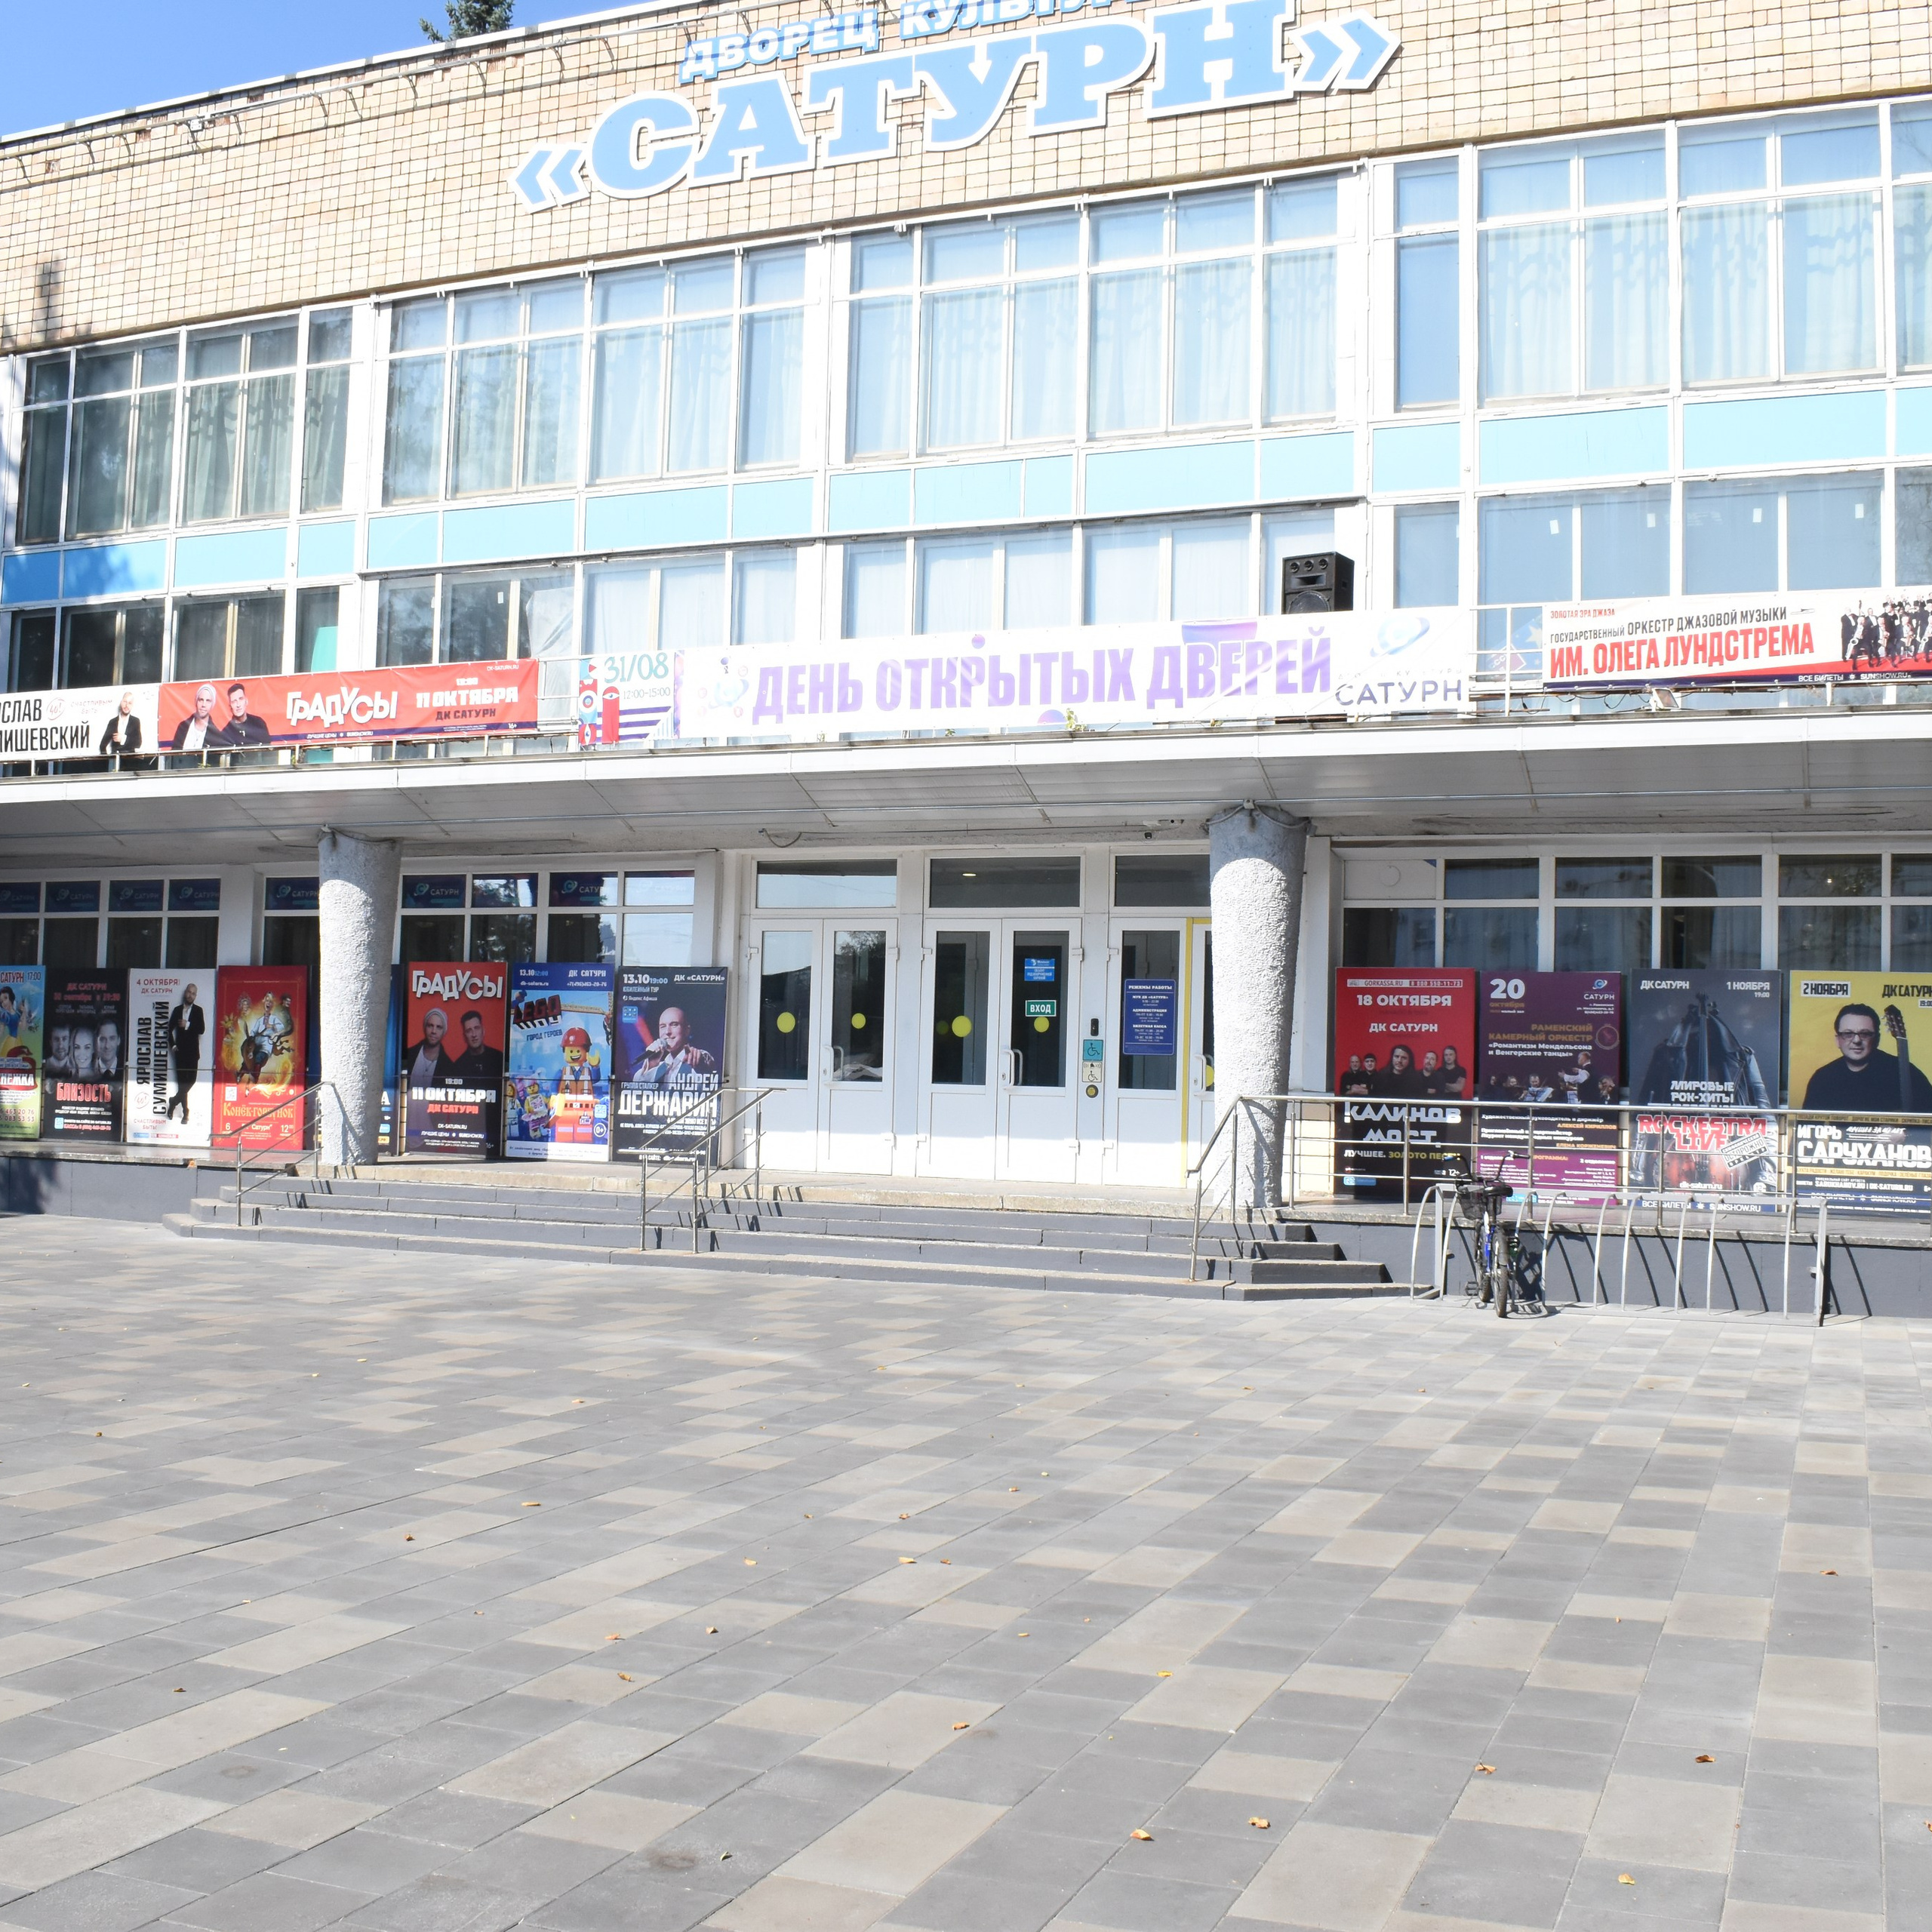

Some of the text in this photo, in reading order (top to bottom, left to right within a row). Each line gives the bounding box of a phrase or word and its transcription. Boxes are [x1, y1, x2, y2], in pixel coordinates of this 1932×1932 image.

[680, 0, 1151, 84] ДВОРЕЦ КУЛЬ
[506, 0, 1403, 214] «САТУРН»
[1550, 608, 1615, 619] ЗОЛОТАЯ ЭРА ДЖАЗА
[1550, 606, 1786, 644] ГОСУДАРСТВЕННЫЙ ОРКЕСТР ДЖАЗОВОЙ МУЗЫКИ
[1550, 623, 1814, 678] ИМ. ОЛЕГА ЛУНДСТРЕМА
[605, 652, 669, 684] 31/08
[752, 626, 1331, 725] ДЕНЬ ОТКРЫТЫХ ДВЕРЕЙ
[417, 687, 518, 708] 11 ОКТЯБРЯ
[623, 687, 671, 700] 12:00-15:00
[1335, 679, 1462, 706] САТУРН
[0, 699, 42, 724] СЛАВ
[435, 708, 496, 721] ДК САТУРН
[27, 971, 41, 980] 17:00
[623, 974, 650, 984] 13.10
[1490, 978, 1525, 999] 20
[1640, 980, 1770, 990] ДК САТУРН 1 НОЯБРЯ
[1803, 983, 1809, 994] 2
[1810, 983, 1848, 995] НОЯБРЯ
[1882, 984, 1898, 998] ДК
[1356, 995, 1452, 1006] 18 ОКТЯБРЯ
[513, 994, 561, 1024] LEGO
[1030, 1004, 1051, 1014] ВХОД
[515, 1015, 562, 1029] ШОУ
[1369, 1023, 1438, 1032] ДК САТУРН
[1531, 1023, 1593, 1032] РАМЕНСКИЙ
[526, 1029, 562, 1041] ГОРОД ГЕРОЕВ
[1488, 1032, 1545, 1041] КАМЕРНЫЙ
[137, 1017, 151, 1085] ЯРОСЛАВ
[152, 1001, 170, 1115] СУМИШЕВСКИЙ
[668, 1071, 718, 1091] АНДРЕЙ
[1670, 1080, 1734, 1091] МИРОВЫЕ
[56, 1082, 112, 1103] БЛИЗОСТЬ
[411, 1087, 497, 1103] 11 ОКТЯБРЯ
[1671, 1092, 1734, 1103] РОК-ХИТЫ
[427, 1103, 479, 1114] ДК САТУРН
[618, 1090, 718, 1118] ДЕРЖАВИН
[225, 1122, 231, 1131] 6
[1636, 1114, 1768, 1136] ROCKESTRA
[1797, 1124, 1842, 1140] ИГОРЬ
[1673, 1131, 1728, 1152] LIVE
[1344, 1149, 1386, 1158] ЛУЧШЕЕ.
[1724, 1139, 1764, 1161] ОСТОРОЖНО
[1797, 1140, 1932, 1169] САРУХАНОВ
[1679, 1181, 1723, 1190] dk-saturn.ru
